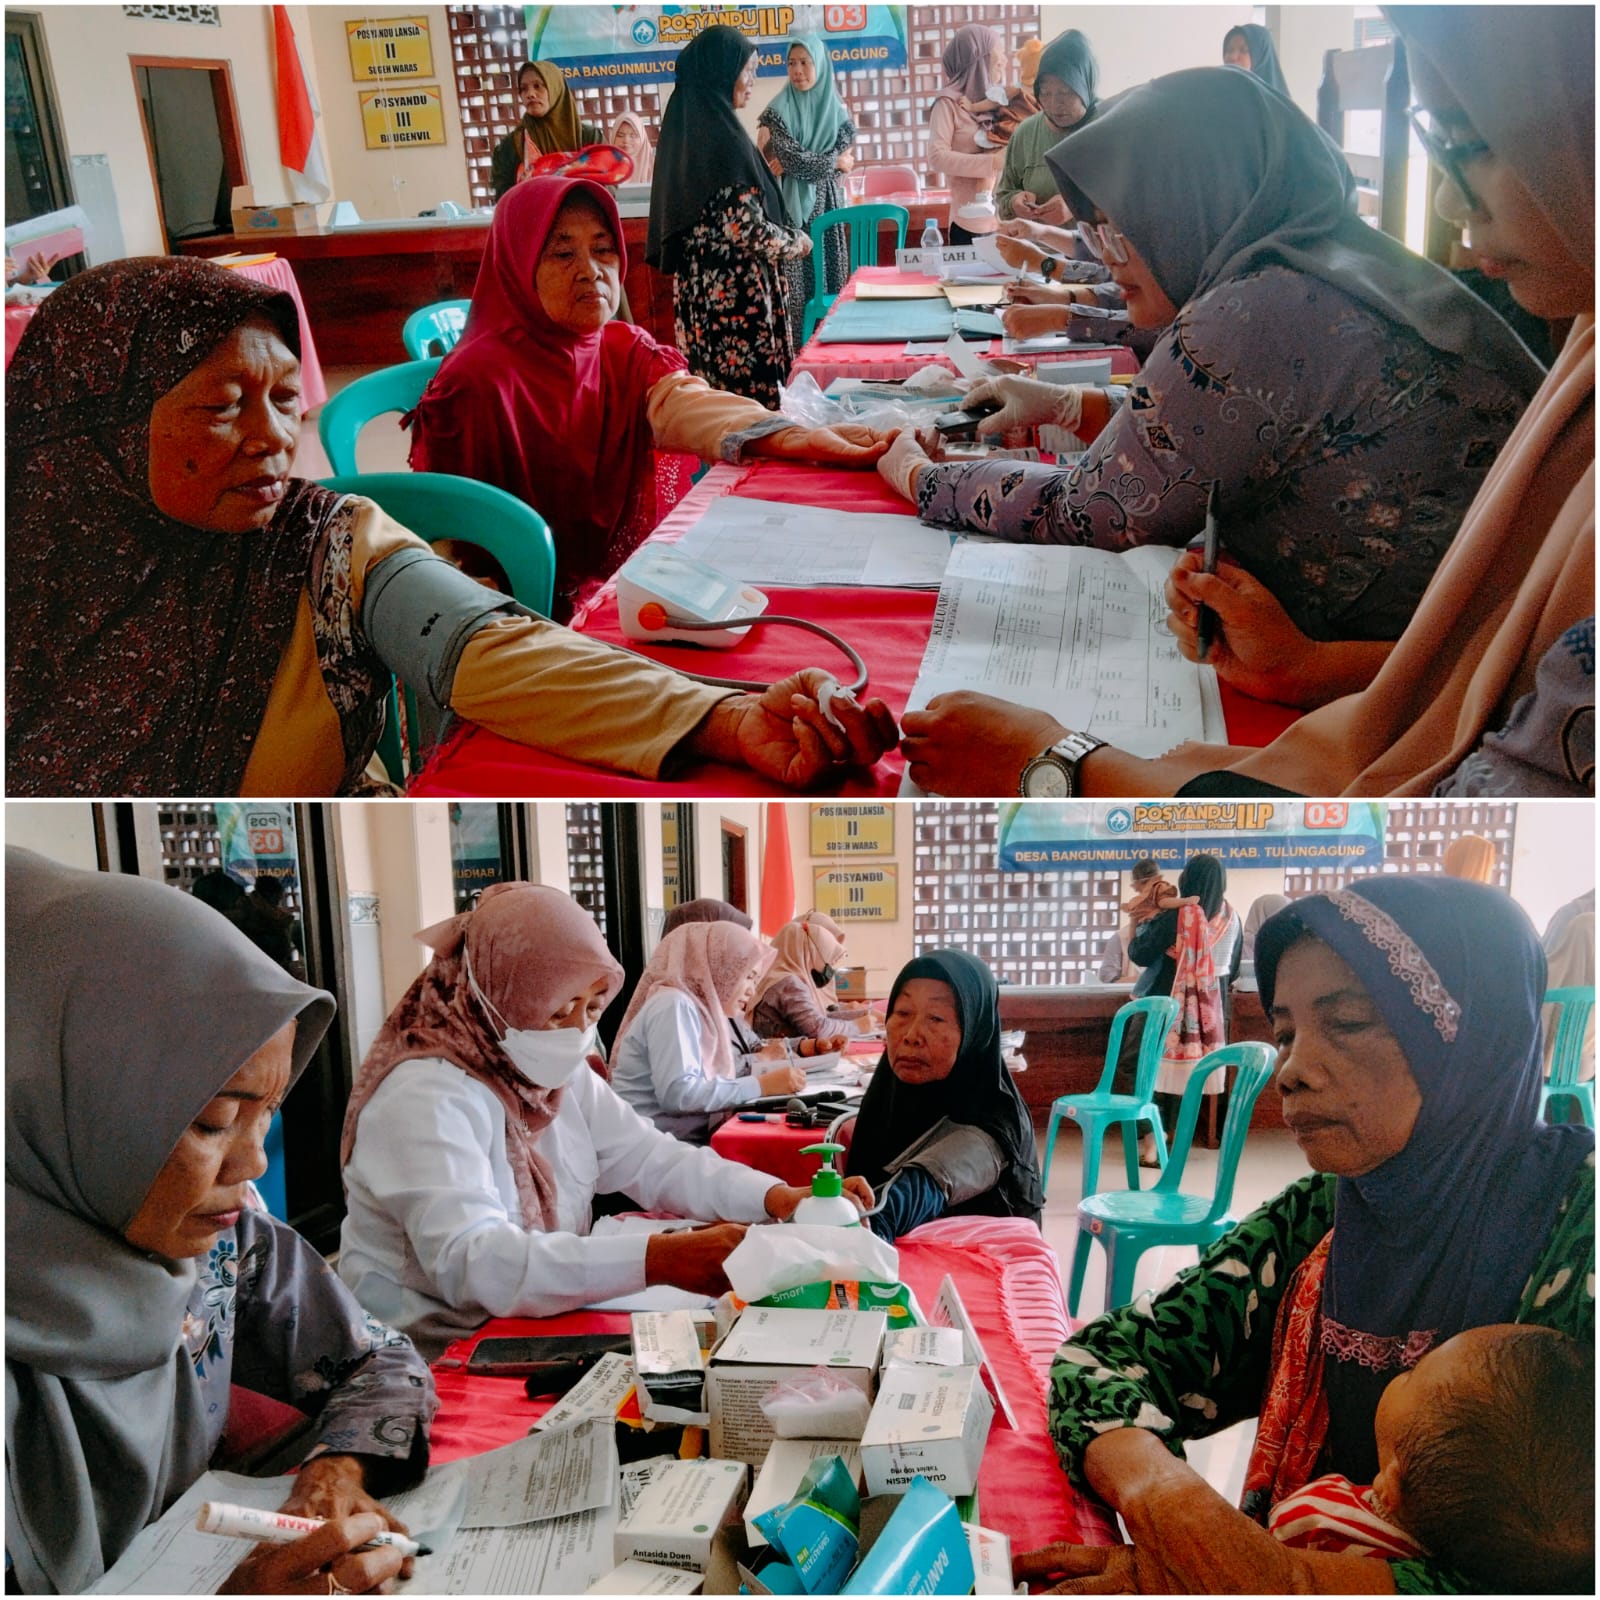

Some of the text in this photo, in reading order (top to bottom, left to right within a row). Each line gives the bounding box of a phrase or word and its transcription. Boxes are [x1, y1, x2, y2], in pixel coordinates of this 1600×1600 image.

[659, 7, 794, 36] POSYANDU ILP
[828, 5, 862, 28] 03
[395, 26, 420, 37] LANSIA
[385, 43, 396, 59] II
[831, 47, 889, 61] GAGUNG
[757, 53, 786, 67] KAB.
[392, 63, 418, 73] WARAS
[559, 61, 677, 79] ESA BANGUNMULYO
[374, 95, 427, 108] POSYANDU
[396, 111, 411, 128] III
[904, 251, 965, 264] LAKAH
[932, 587, 952, 636] KELUARGA
[859, 805, 885, 815] LANSIA
[1135, 802, 1274, 830] POSYANDU ILP
[1308, 804, 1344, 825] 03
[847, 821, 858, 836] II
[851, 841, 879, 850] WARAS
[1015, 851, 1048, 862] DESA
[1052, 849, 1149, 861] BANGUNMULYO
[1152, 848, 1181, 859] KEC.
[1229, 847, 1260, 858] KAB.
[1264, 845, 1366, 857] TULUNGAGUNG
[828, 872, 884, 883] POSYANDU
[849, 888, 864, 902] III
[830, 907, 882, 917] BOUGENVIL
[771, 1285, 805, 1303] Smart
[885, 1473, 947, 1486] GUANESIN
[632, 1548, 691, 1560] Antasida Doen
